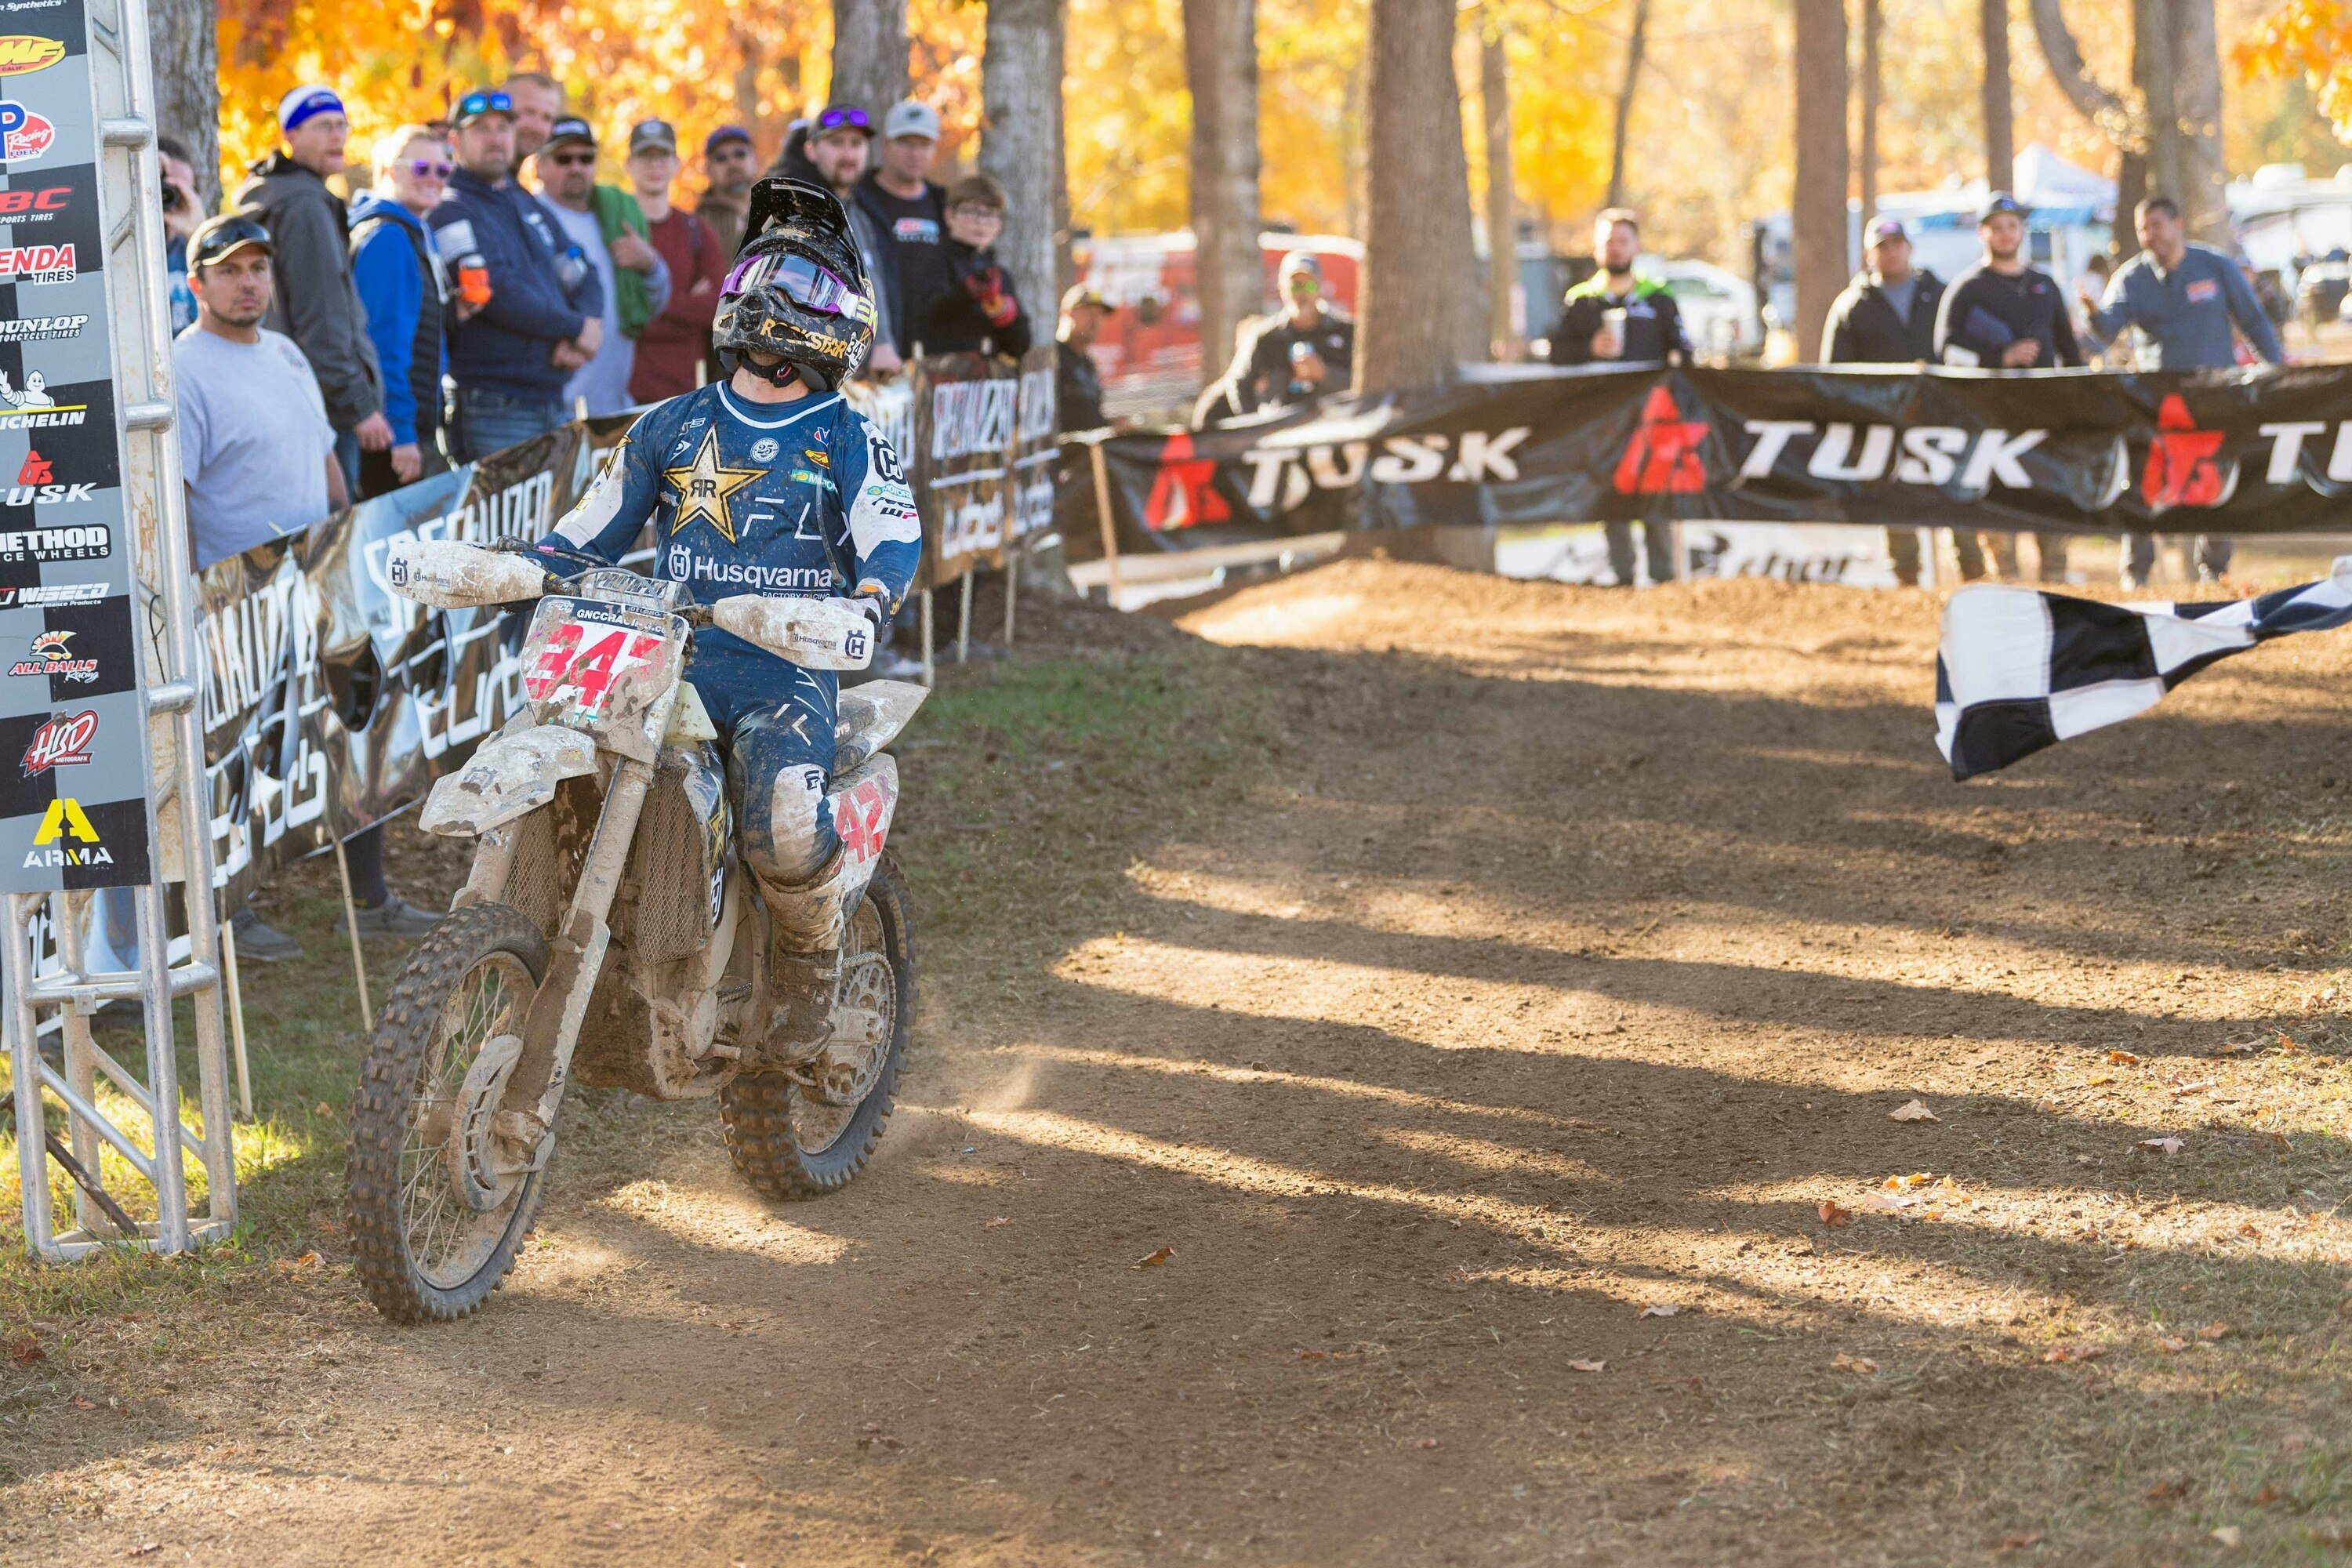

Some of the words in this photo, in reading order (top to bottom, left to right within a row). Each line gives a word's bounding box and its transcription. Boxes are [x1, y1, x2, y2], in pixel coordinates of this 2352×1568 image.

[6, 0, 62, 12] Synthetics
[9, 128, 56, 150] Racing
[0, 187, 72, 212] BC
[0, 215, 27, 224] PORTS
[31, 213, 54, 222] TIRES
[34, 270, 74, 283] TIRES
[52, 328, 81, 339] TIRES
[757, 444, 774, 456] 25
[1739, 419, 2050, 490] TUSK
[1242, 426, 1532, 511] TUSK
[0, 482, 97, 506] USK
[3, 552, 25, 562] CE
[34, 546, 109, 560] WHEELS
[695, 555, 832, 589] Husqvarna
[799, 635, 837, 648] Husqvarna
[9, 662, 42, 676] ALL
[43, 659, 98, 673] BALLS
[65, 670, 99, 683] Racing
[22, 847, 114, 868] ARMA
